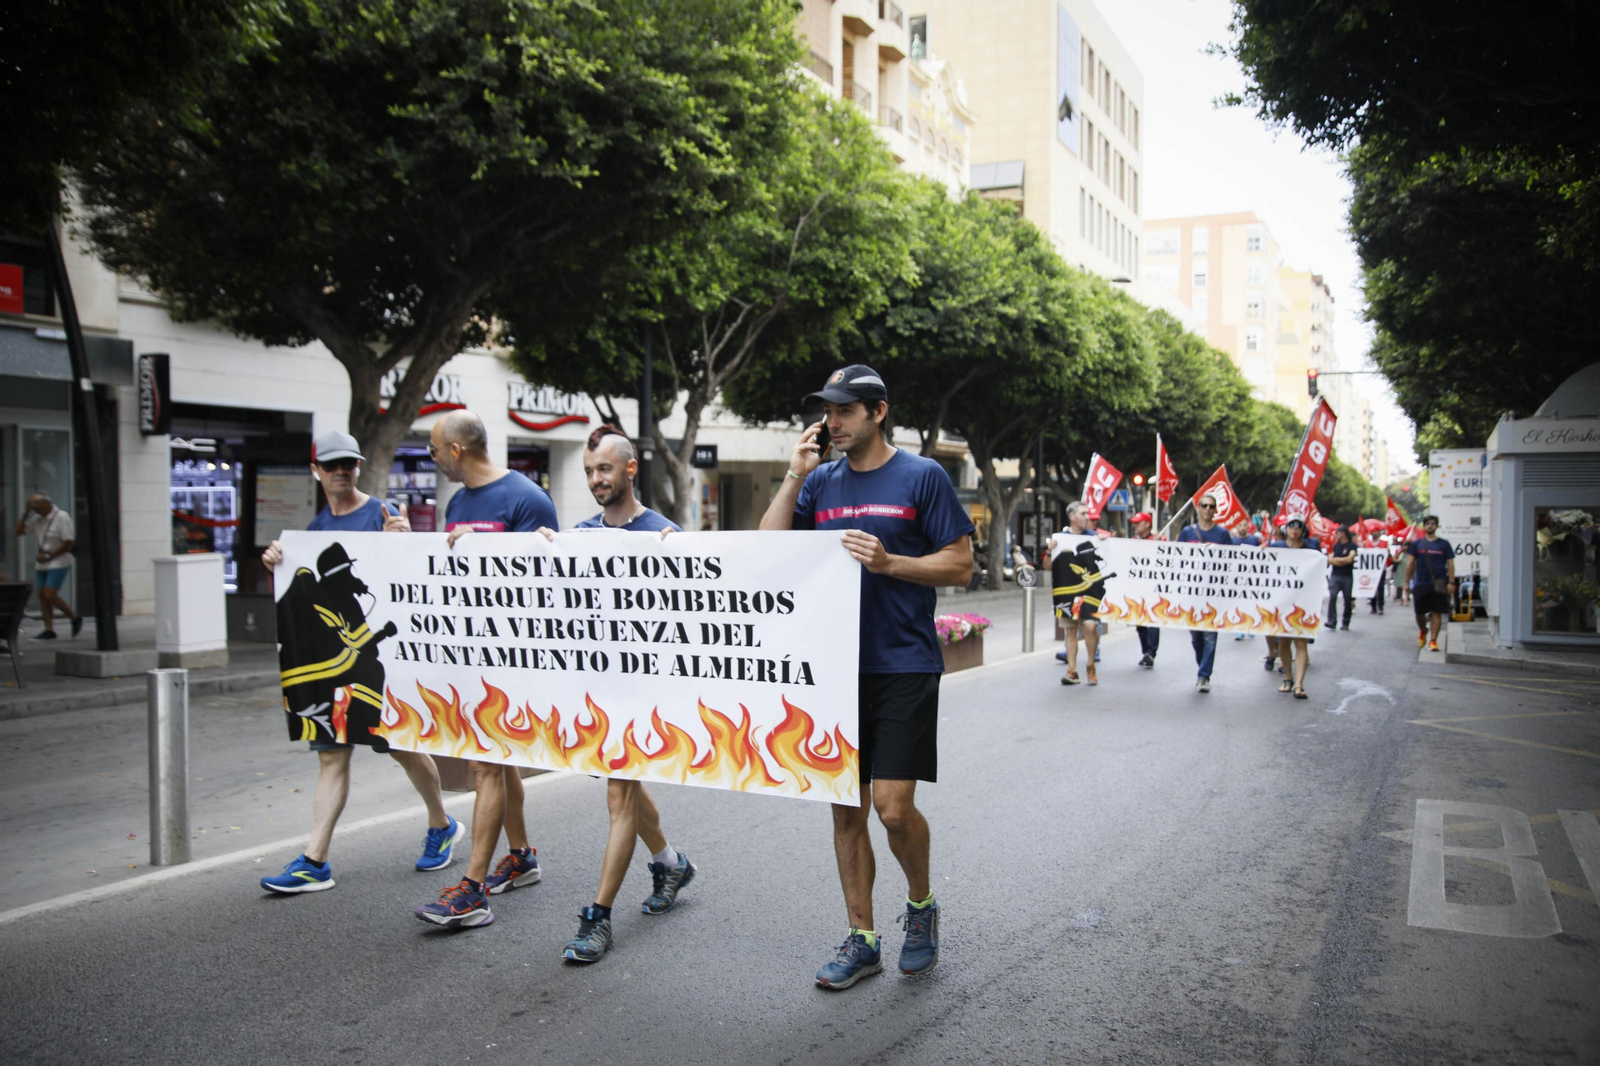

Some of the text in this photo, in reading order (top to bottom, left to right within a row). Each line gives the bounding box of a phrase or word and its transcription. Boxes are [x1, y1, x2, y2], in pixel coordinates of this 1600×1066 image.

[140, 355, 155, 431] PRIMOR
[508, 382, 590, 417] PRIMOR
[1302, 411, 1334, 488] UGT
[1522, 429, 1544, 445] El
[869, 506, 904, 514] BOMBEROS
[1157, 545, 1278, 561] SIN INVERSIÓN
[427, 555, 722, 580] LAS INSTALACIONES
[1129, 556, 1299, 576] NO SE PUEDE DAR UN
[1128, 569, 1304, 590] SERVICIO DE CALIDAD
[1153, 583, 1272, 600] AL CIUDADANO
[389, 582, 795, 615] DEL PARQUE DE BOMBEROS
[410, 612, 761, 648] SON LA VERGÜENZA DEL
[394, 640, 815, 686] AYUNTAMIENTO DE ALMERÍA
